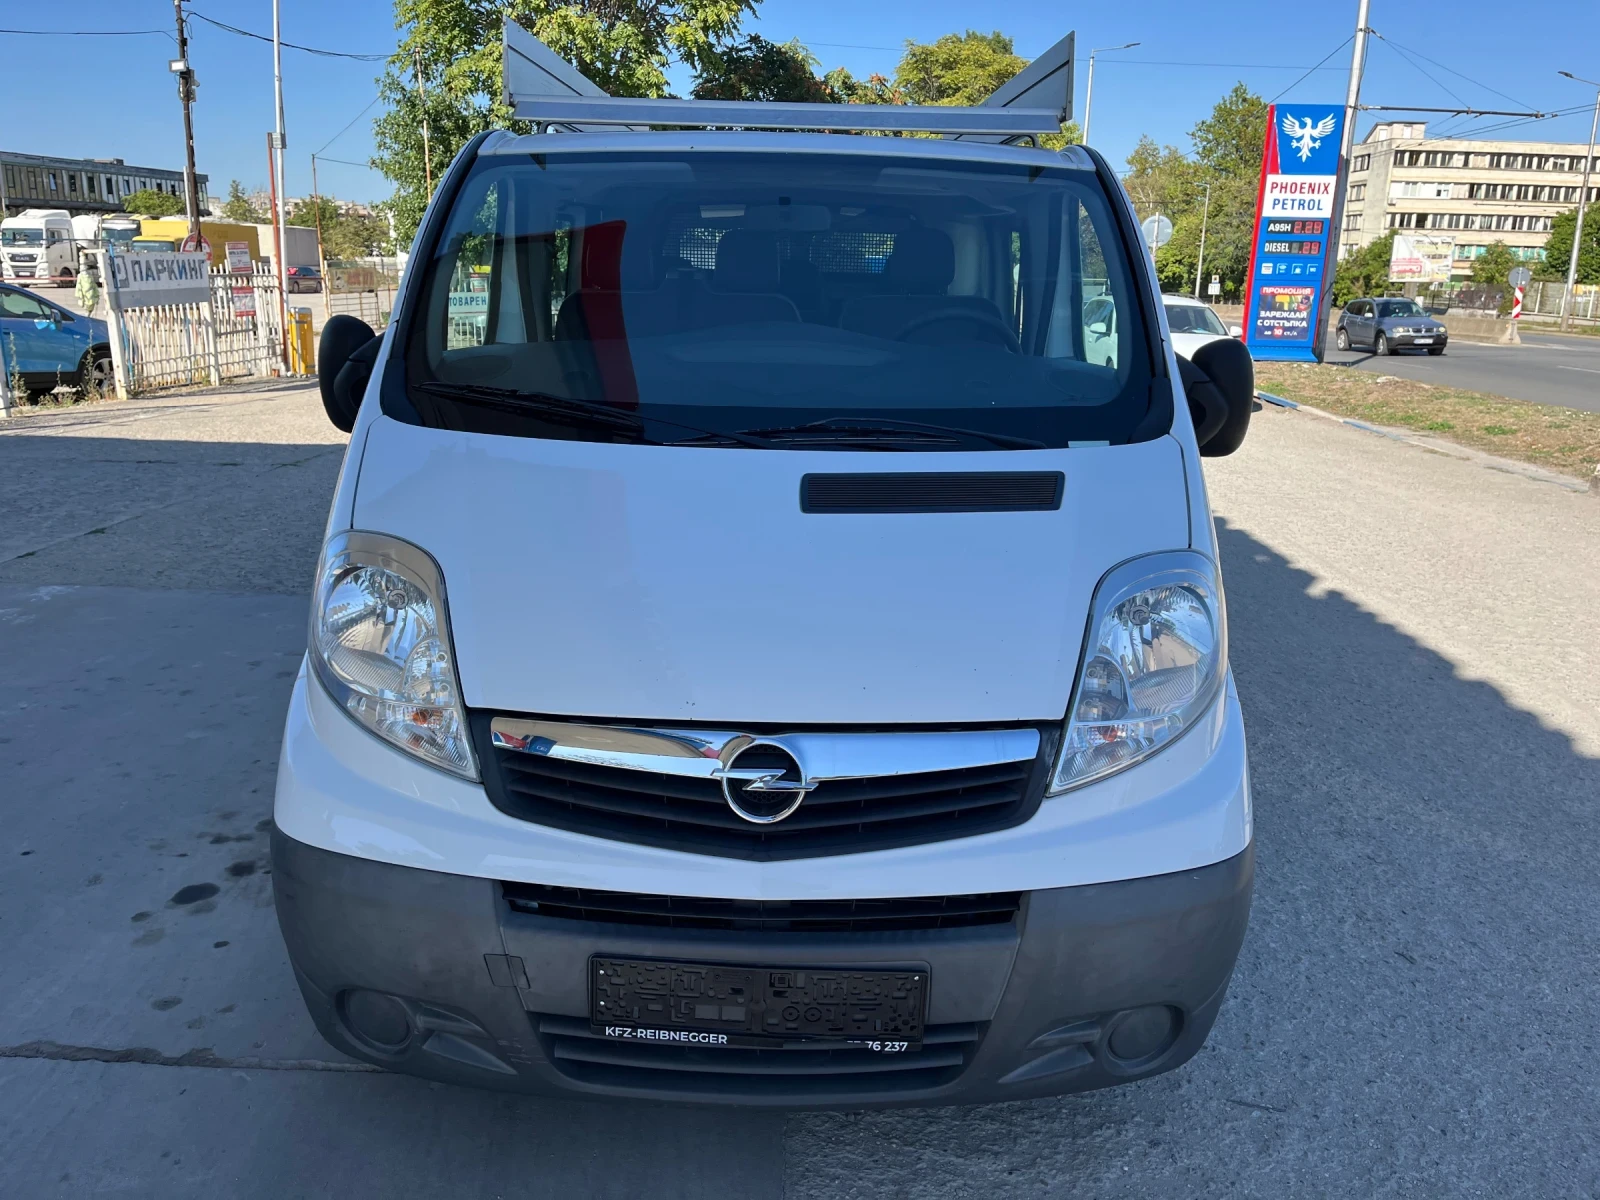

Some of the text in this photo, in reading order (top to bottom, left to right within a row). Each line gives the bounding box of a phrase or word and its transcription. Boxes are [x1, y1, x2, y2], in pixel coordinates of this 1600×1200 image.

[1270, 181, 1331, 195] PHOENIX
[1272, 198, 1323, 211] PETROL
[1264, 242, 1290, 252] DIESEL
[130, 258, 206, 282] ПАРКИНГ
[1262, 287, 1311, 295] ПРОМОЦИЯ
[449, 297, 486, 306] ТОВАРЕН
[1260, 310, 1307, 319] ЗАРЕЖДАЙ
[1263, 319, 1308, 327] ОТСТЪПКА
[605, 1026, 728, 1044] KFZ-REIBNEGGER
[884, 1041, 908, 1052] 237
